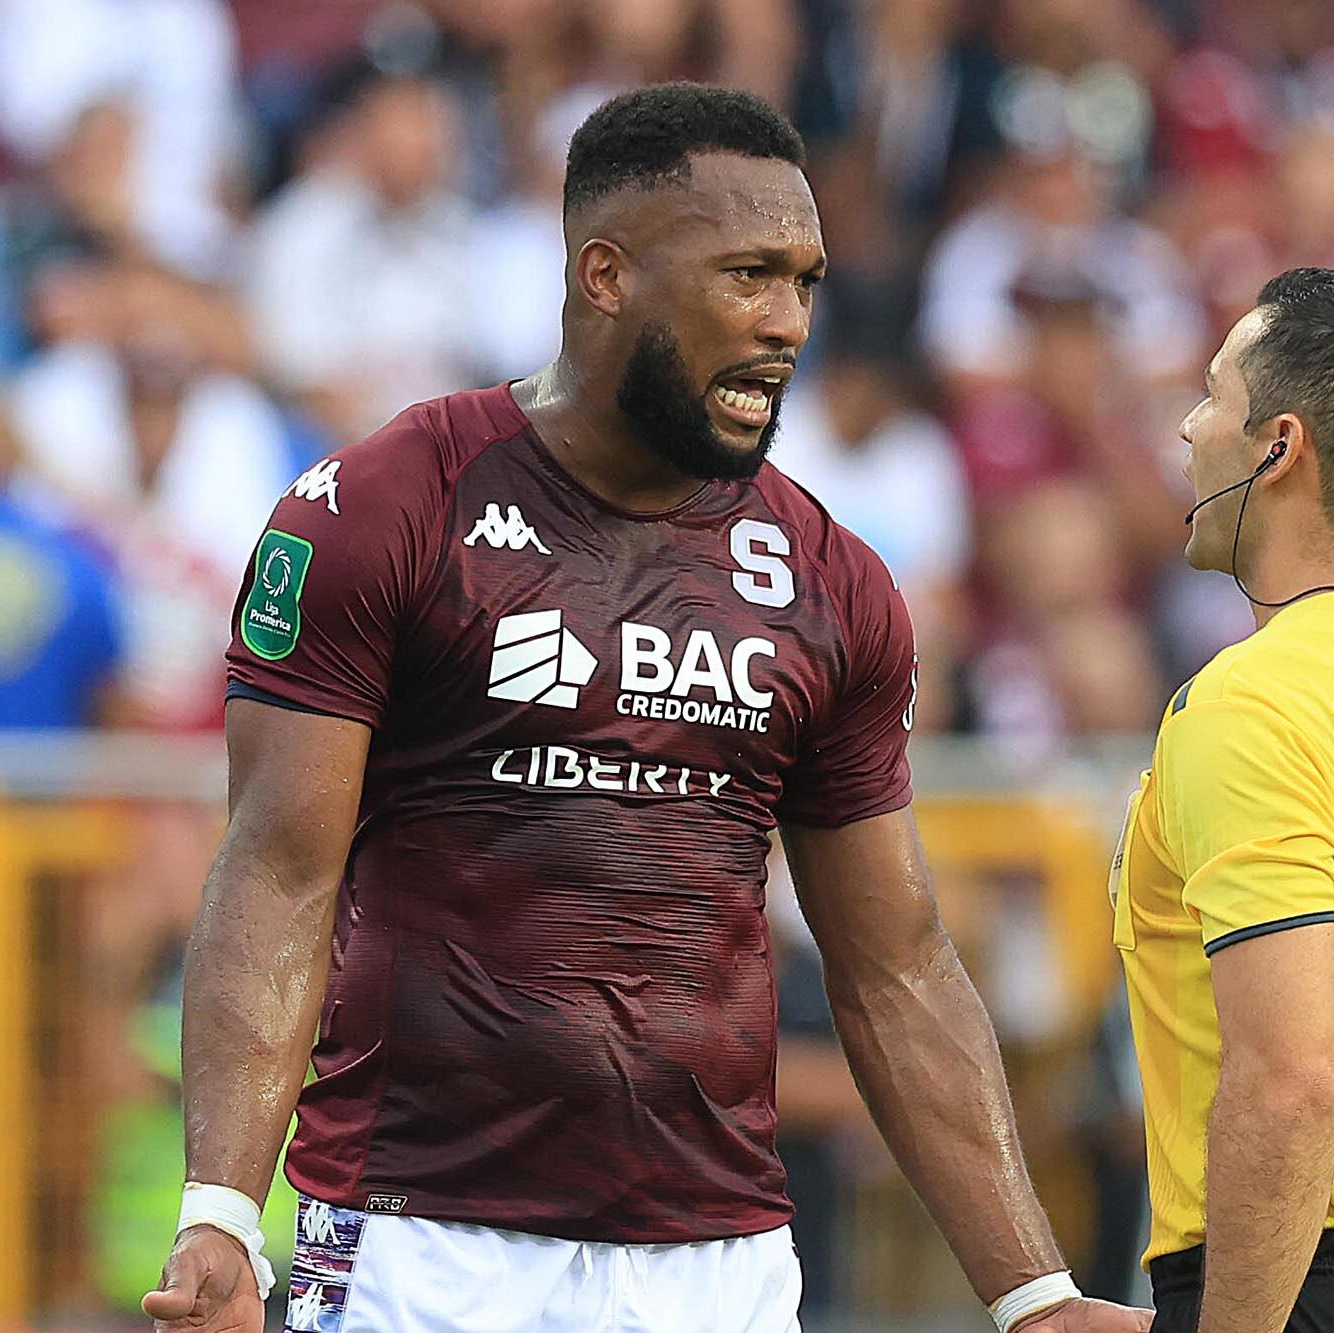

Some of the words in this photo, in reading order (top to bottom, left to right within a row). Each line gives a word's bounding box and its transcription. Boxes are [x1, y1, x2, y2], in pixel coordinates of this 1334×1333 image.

[730, 517, 795, 609] S
[249, 608, 291, 632] Promerica
[619, 621, 776, 709] BAC
[616, 692, 771, 732] CREDOMATIC
